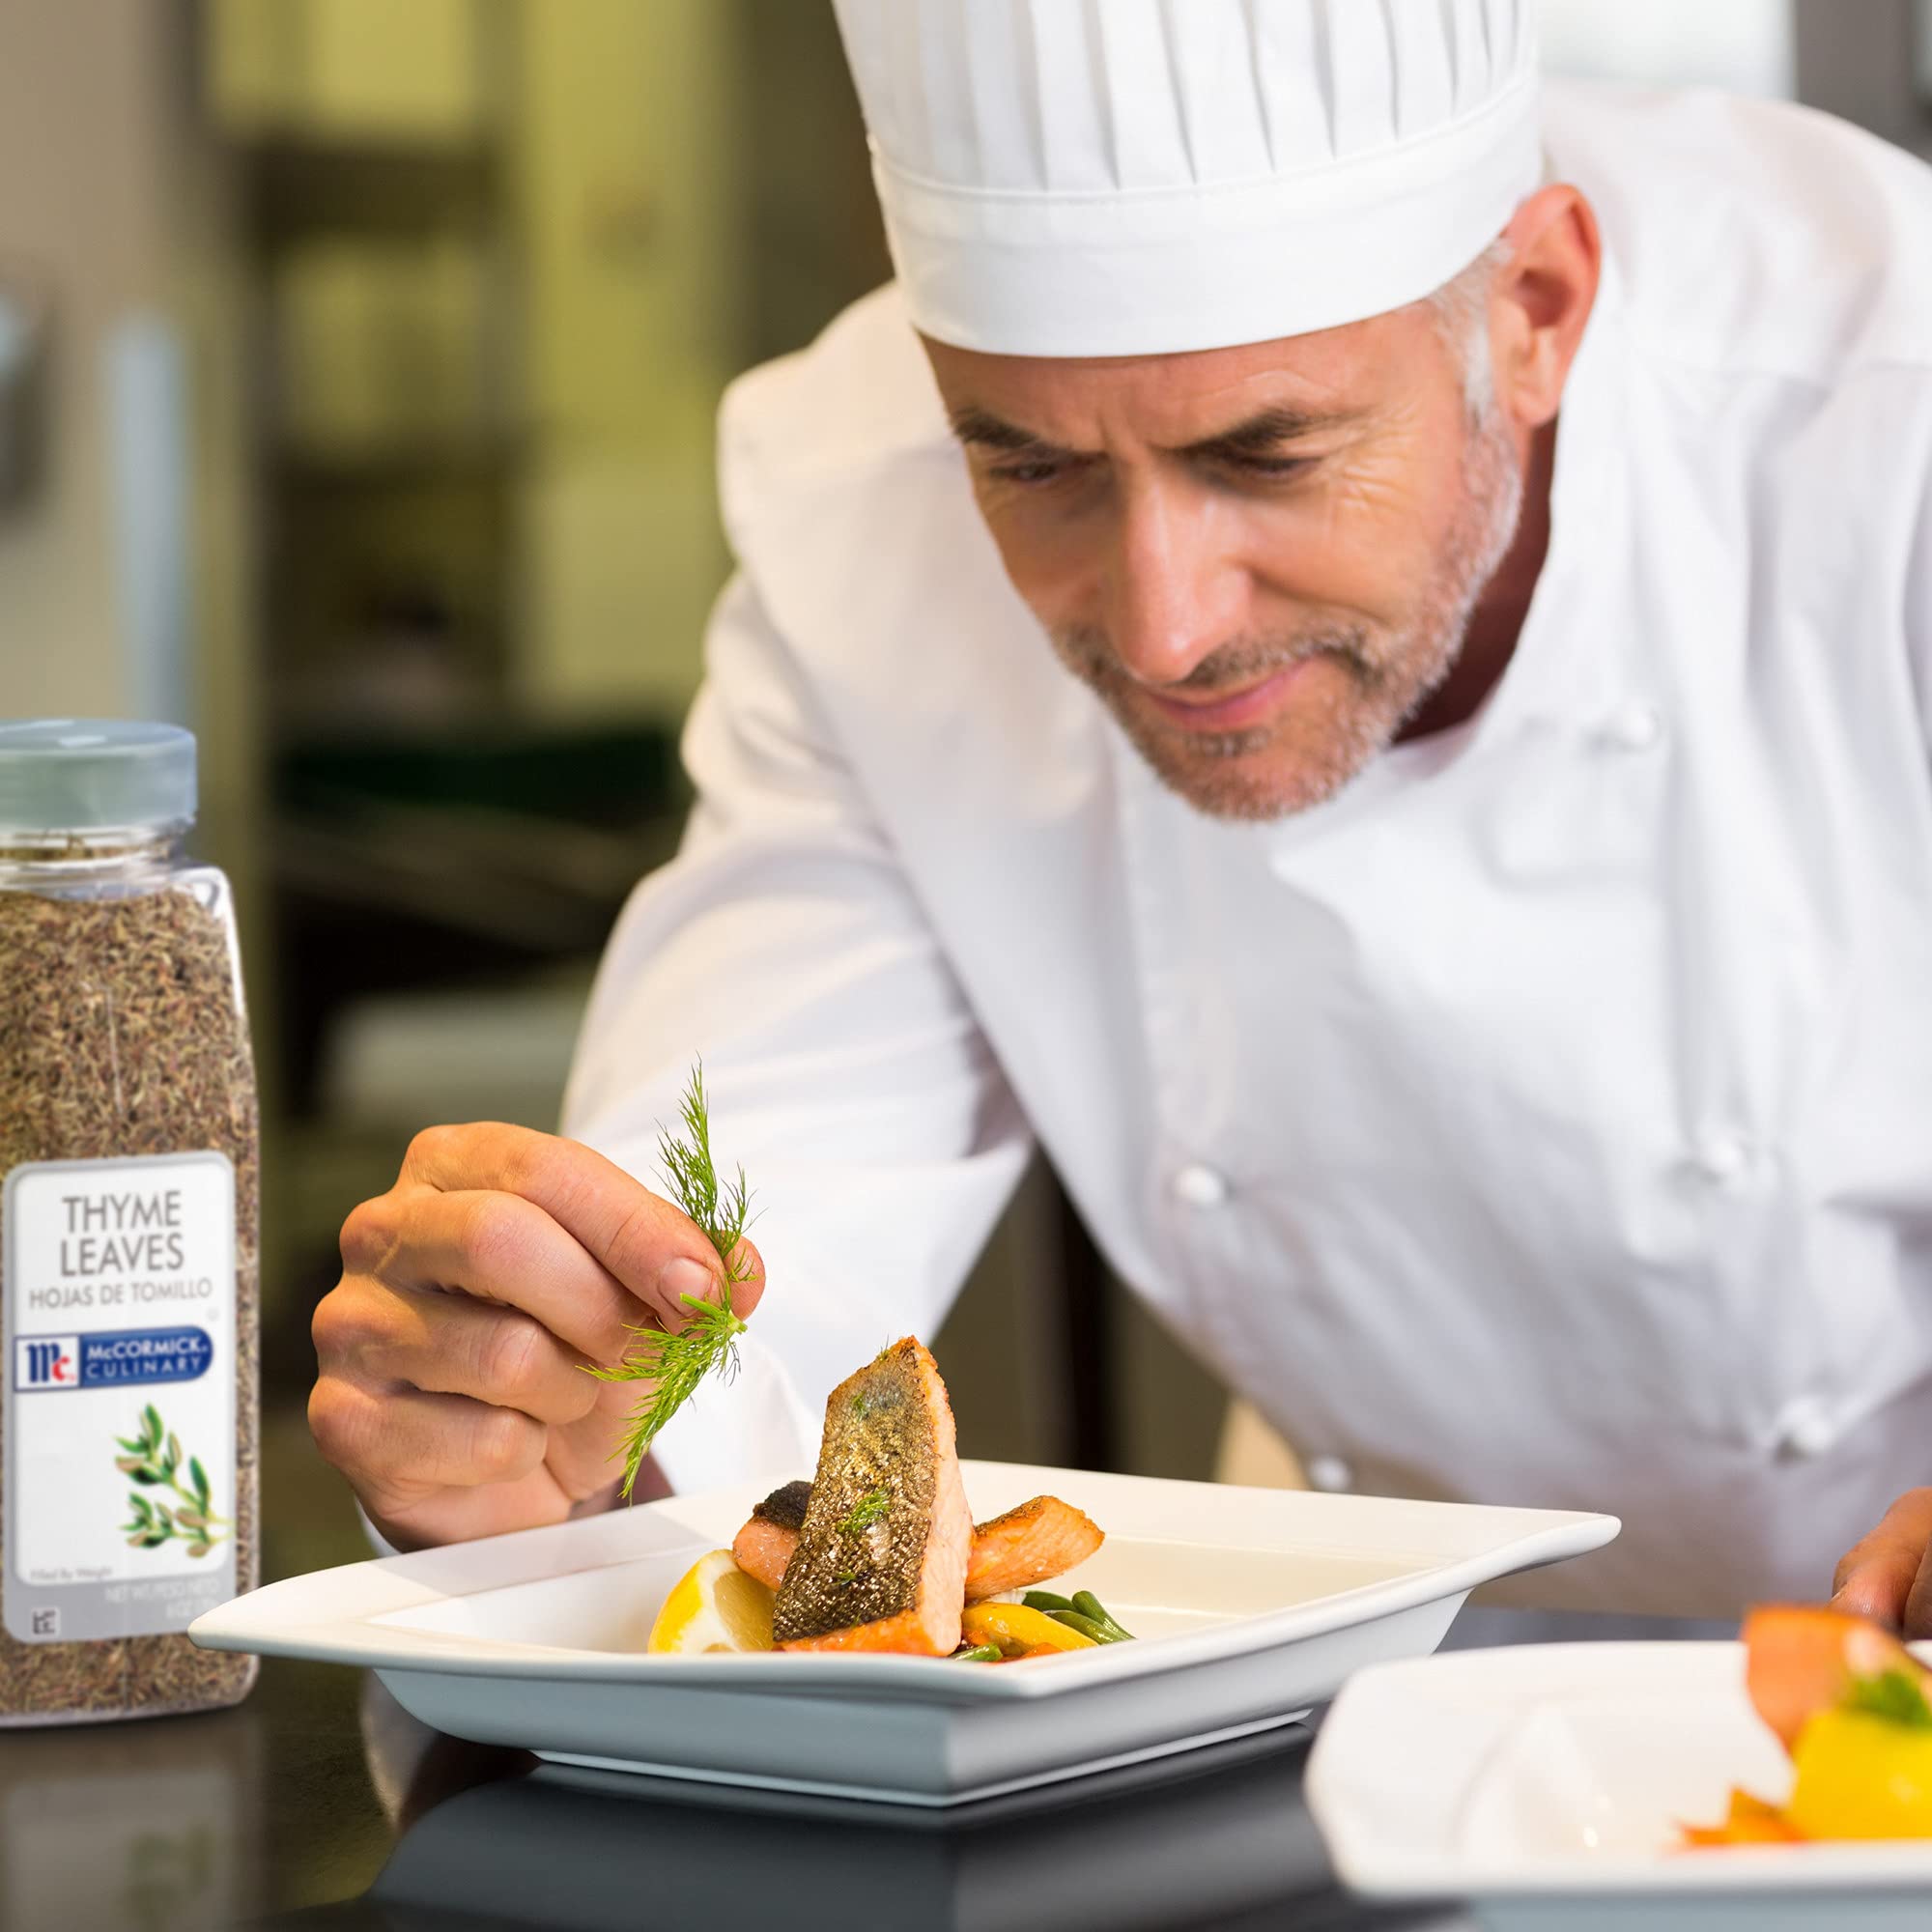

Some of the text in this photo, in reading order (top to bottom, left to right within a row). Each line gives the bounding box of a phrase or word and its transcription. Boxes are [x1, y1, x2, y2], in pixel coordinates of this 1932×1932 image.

[62, 1190, 182, 1234] THYME
[60, 1233, 184, 1277] LEAVES
[30, 1277, 213, 1309] HOJAS DE TOMILLO
[86, 1357, 202, 1378] CULINARY
